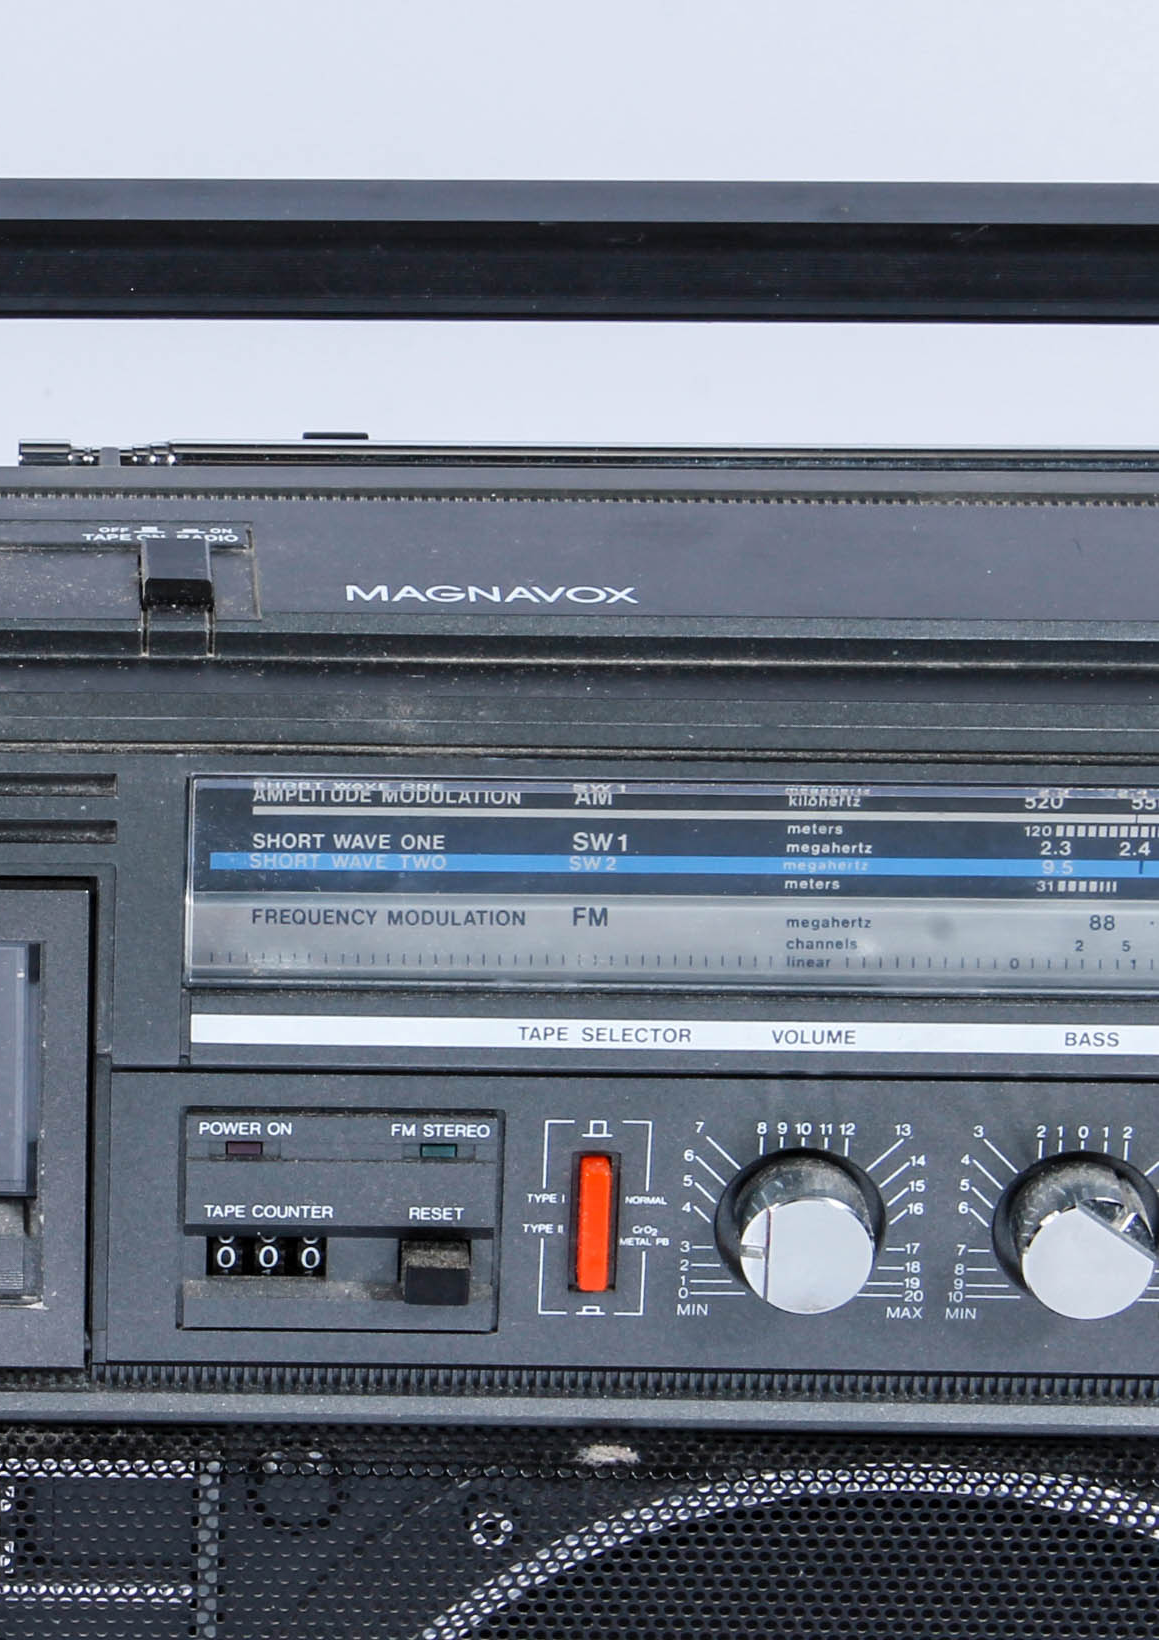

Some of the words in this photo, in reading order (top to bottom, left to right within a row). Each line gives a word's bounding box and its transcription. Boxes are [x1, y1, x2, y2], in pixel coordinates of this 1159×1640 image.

[81, 533, 132, 541] TAPE
[345, 585, 639, 603] MAGNAVOX
[252, 788, 372, 803] AMPLITUDE
[381, 790, 521, 805] MODULATION
[574, 791, 613, 805] AM
[1131, 799, 1159, 811] 55
[787, 823, 843, 835] meters
[1024, 825, 1052, 837] 120
[252, 832, 325, 850] SHORT
[333, 834, 391, 850] WAVE
[401, 834, 445, 850] ONE
[786, 842, 873, 856] megahertz
[1041, 841, 1072, 856] 2.3
[1119, 841, 1151, 857] 2.4
[249, 853, 322, 870] SHORT
[331, 853, 386, 870] WAVE
[401, 853, 447, 871] TWO
[783, 859, 869, 873] megahertz
[784, 878, 840, 890] meters
[1036, 880, 1054, 893] 31
[252, 908, 378, 926] FREQUENCY
[387, 909, 527, 926] MODULATION
[572, 906, 609, 927] FM
[1089, 914, 1115, 931] 88
[786, 917, 872, 931] megahertz
[786, 937, 858, 950] channels
[1074, 940, 1084, 952] 2
[1122, 940, 1131, 952] 5
[786, 955, 831, 968] linear
[517, 1026, 569, 1041] TAPE
[581, 1026, 692, 1043] SELECTOR
[771, 1029, 856, 1045] VOLUME
[1064, 1031, 1120, 1047] BASS
[198, 1122, 262, 1136] POWER
[267, 1122, 293, 1136] ON
[391, 1123, 416, 1138] FM
[422, 1124, 491, 1138] STEREO
[695, 1121, 705, 1134] 7
[757, 1122, 767, 1135] 8
[777, 1122, 788, 1135] 9
[795, 1122, 812, 1135] 10
[819, 1123, 833, 1135] 11
[840, 1123, 856, 1136] 12
[895, 1123, 912, 1136] 13
[973, 1125, 984, 1138] 3
[1036, 1125, 1047, 1138] 2
[1078, 1126, 1089, 1139] 0
[1123, 1126, 1133, 1139] 2
[683, 1149, 694, 1162] 6
[910, 1154, 926, 1167] 14
[960, 1154, 970, 1166] 4
[683, 1175, 693, 1187] 5
[909, 1180, 926, 1192] 15
[959, 1179, 970, 1191] 5
[527, 1193, 557, 1204] TYPE
[624, 1195, 668, 1206] NORMAL
[203, 1205, 246, 1218] TAPE
[251, 1205, 334, 1219] COUNTER
[408, 1206, 465, 1221] RESET
[681, 1201, 691, 1213] 4
[908, 1203, 924, 1215] 16
[958, 1201, 969, 1214] 6
[522, 1223, 554, 1234] TYPE
[619, 1237, 651, 1247] METAL
[655, 1237, 670, 1247] PB
[680, 1241, 690, 1253] 3
[905, 1243, 920, 1254] 17
[957, 1244, 966, 1256] 7
[680, 1259, 689, 1271] 2
[905, 1261, 921, 1273] 18
[954, 1263, 964, 1275] 8
[905, 1277, 920, 1289] 19
[953, 1278, 963, 1290] 9
[678, 1287, 688, 1299] 0
[904, 1290, 924, 1302] 20
[948, 1291, 963, 1302] 10
[676, 1303, 709, 1316] MIN
[886, 1306, 923, 1319] MAX
[946, 1308, 977, 1319] MIN
